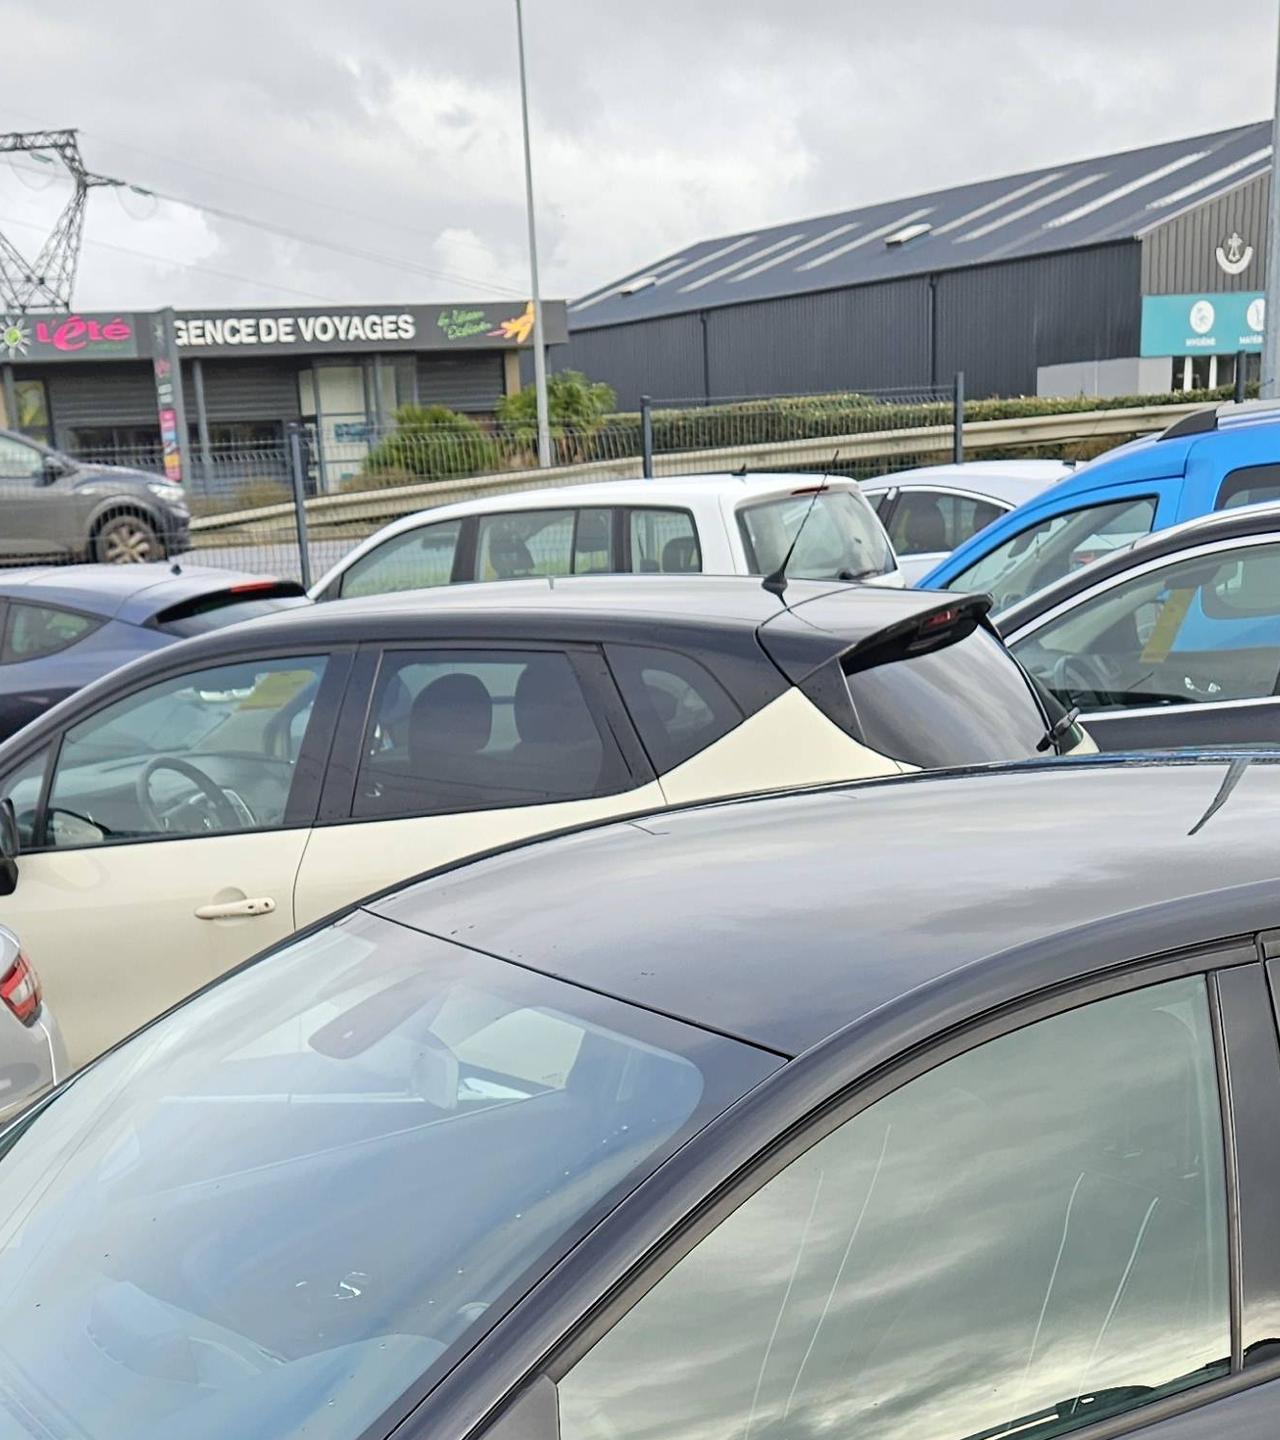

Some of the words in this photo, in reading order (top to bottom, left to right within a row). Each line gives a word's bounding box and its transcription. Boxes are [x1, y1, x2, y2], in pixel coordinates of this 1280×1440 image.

[173, 318, 255, 346] GENCE
[258, 317, 296, 343] DE
[297, 314, 417, 342] VOYAGES
